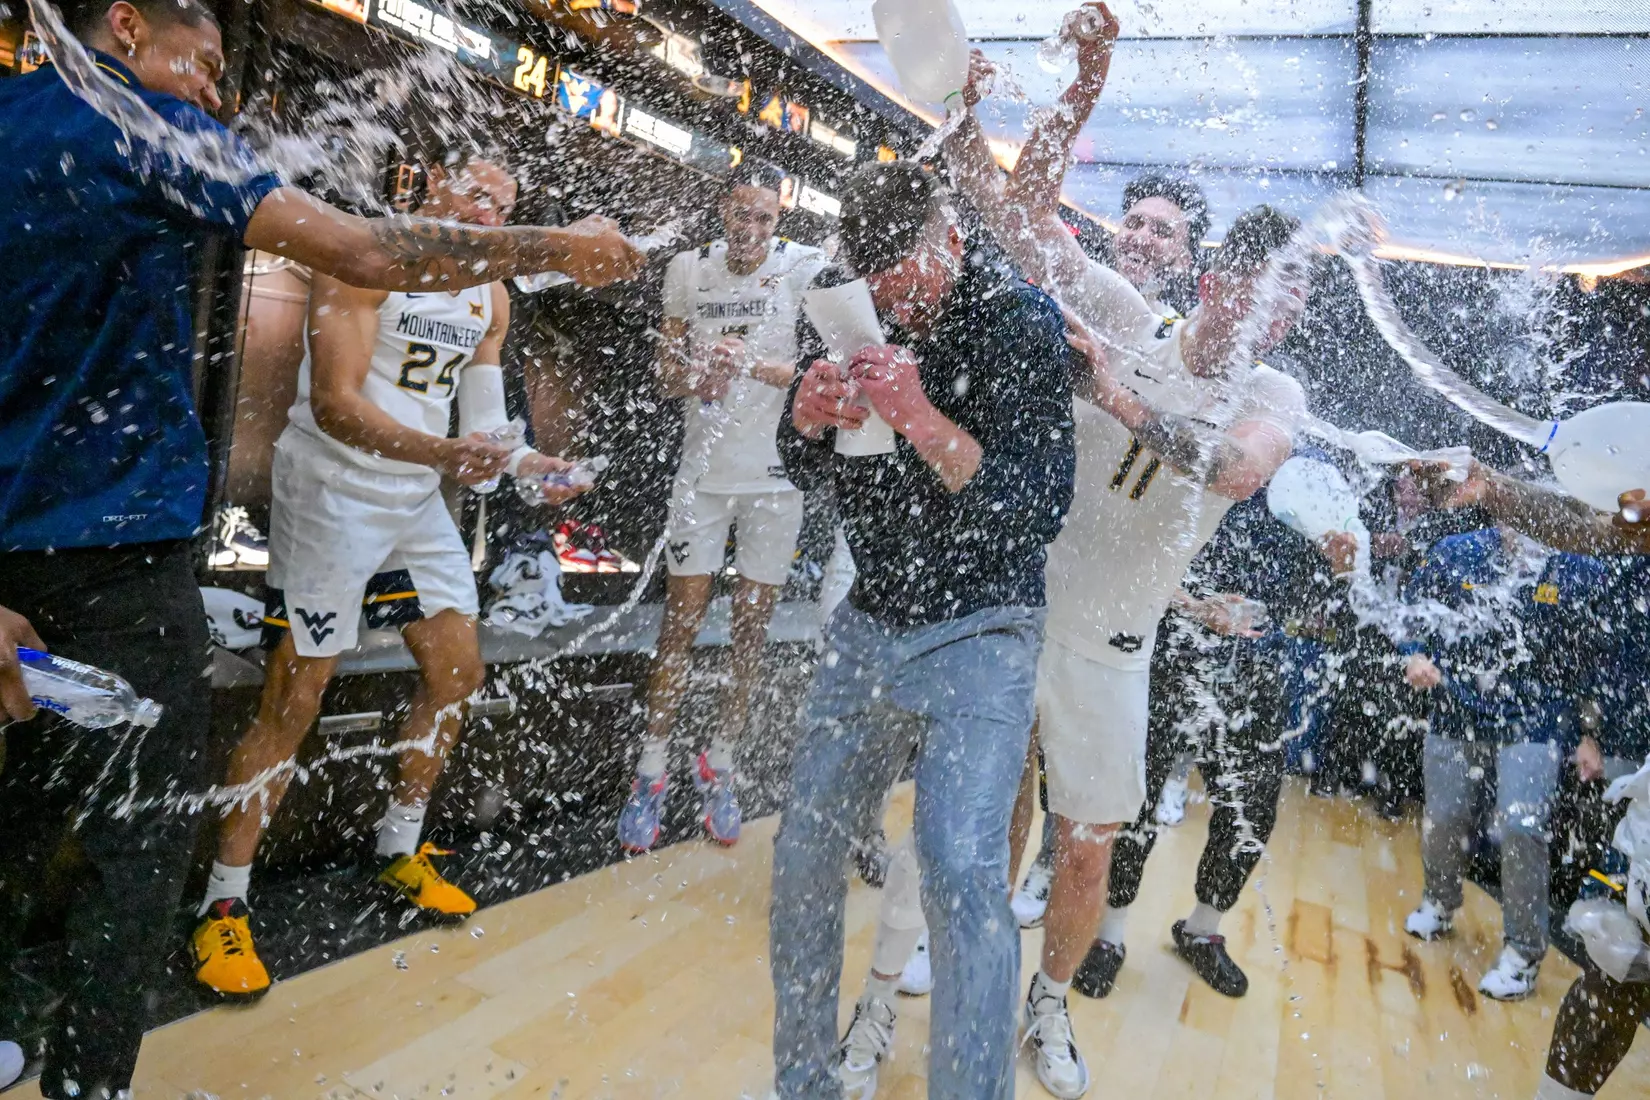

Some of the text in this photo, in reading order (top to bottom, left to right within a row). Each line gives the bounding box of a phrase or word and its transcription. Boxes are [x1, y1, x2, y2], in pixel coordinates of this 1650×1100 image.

[514, 46, 548, 98] 24
[396, 341, 466, 397] 24
[1109, 435, 1161, 500] 11
[103, 514, 149, 523] DRI-FIT
[51, 656, 92, 675] water
